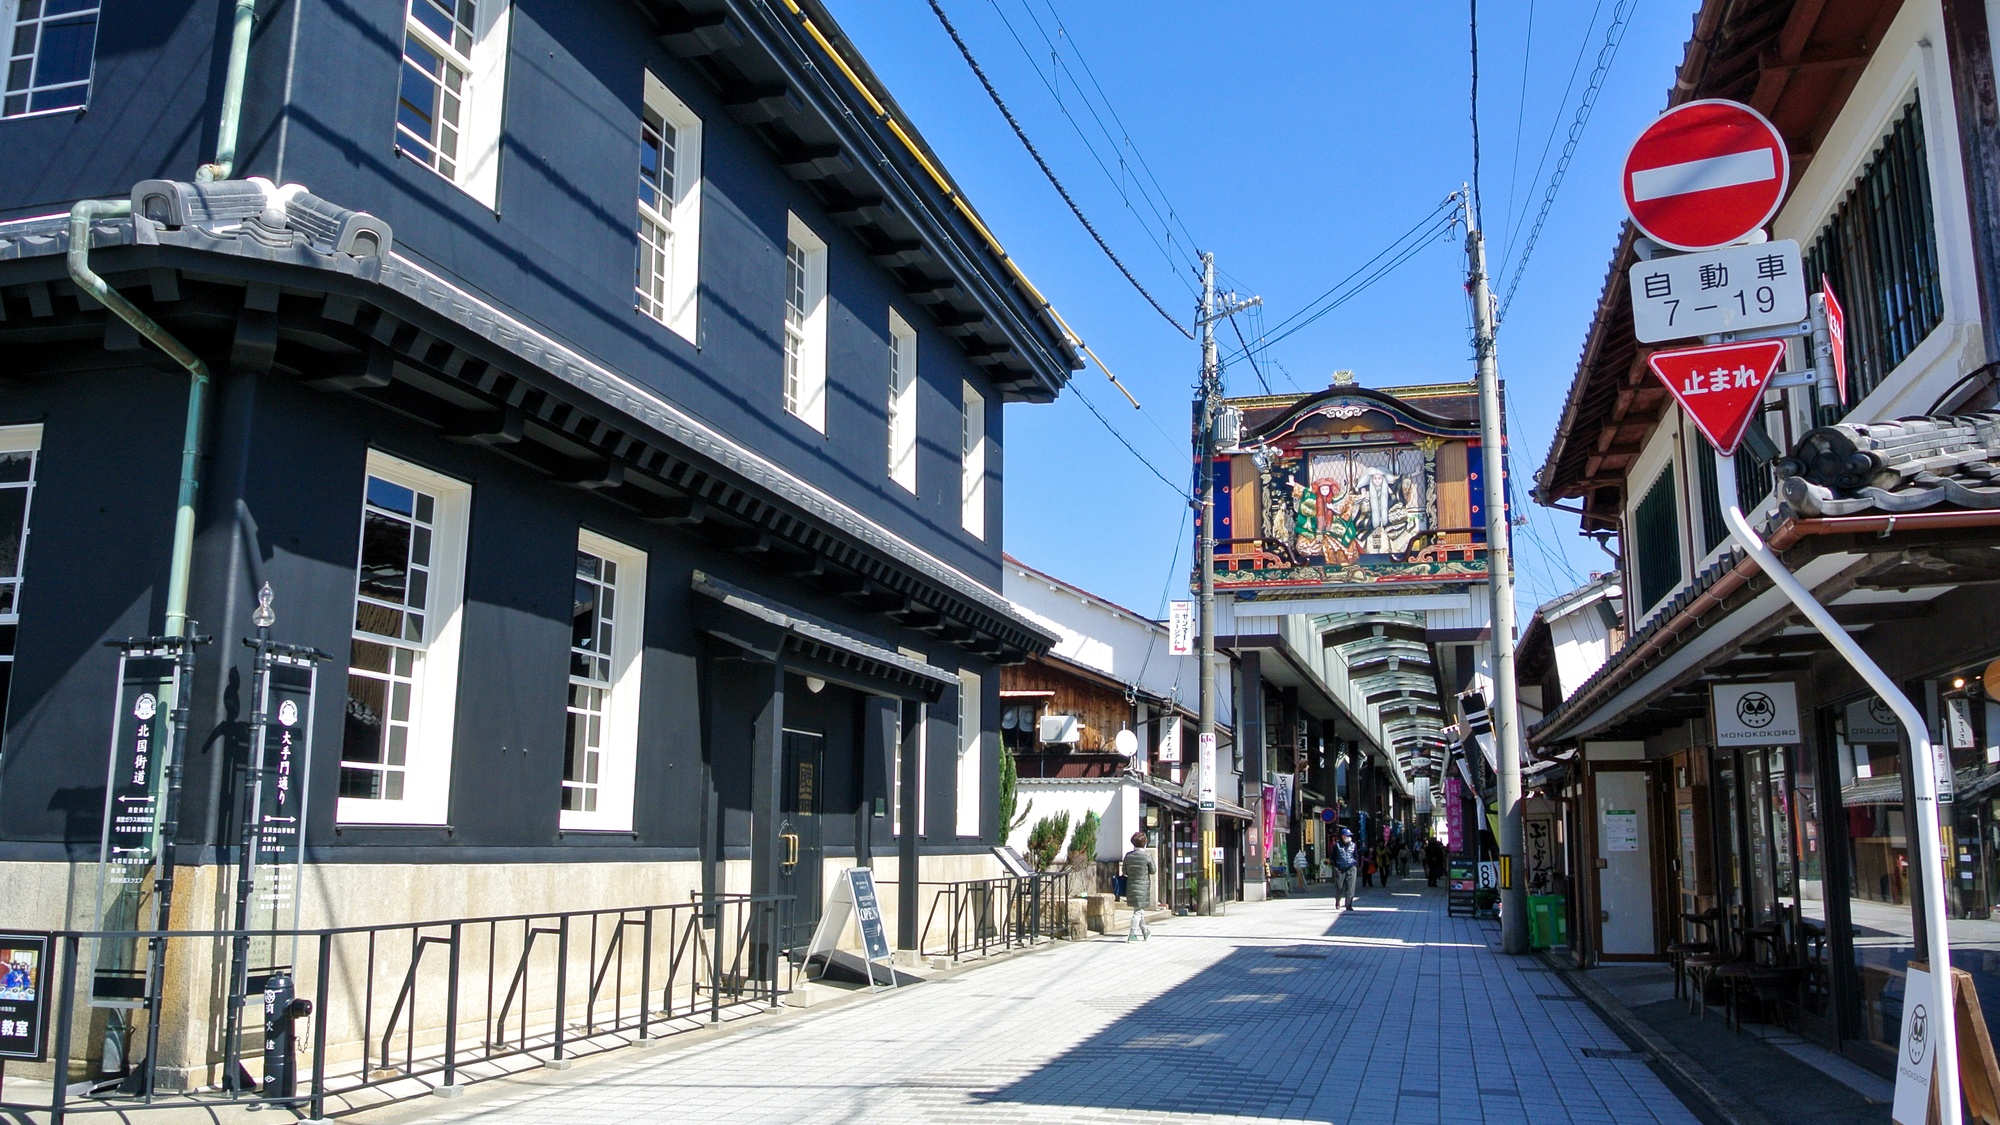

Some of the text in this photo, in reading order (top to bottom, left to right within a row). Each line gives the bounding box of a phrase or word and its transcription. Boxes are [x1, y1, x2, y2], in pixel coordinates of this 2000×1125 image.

[1644, 254, 1788, 299] 自動車
[1681, 364, 1761, 396] 止まれ
[1720, 729, 1796, 739] MONOKOKORO
[132, 724, 150, 785] 北国街道
[277, 730, 292, 805] 大手門通り
[860, 907, 878, 921] OPEN
[1, 1019, 29, 1037] 教室
